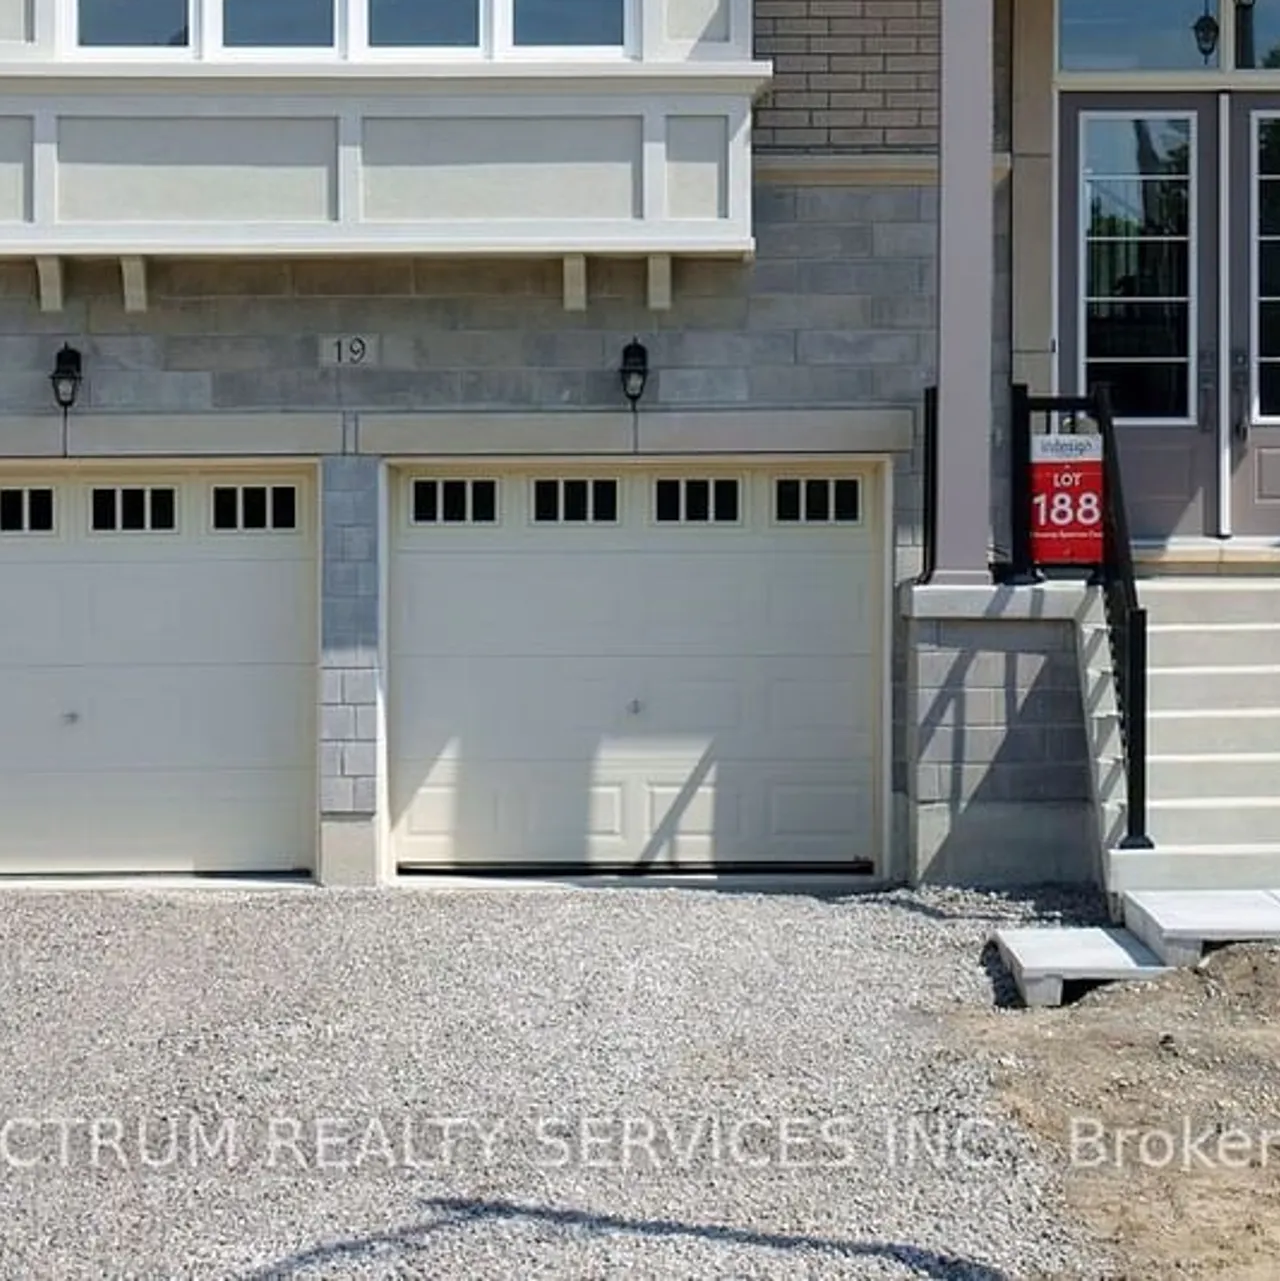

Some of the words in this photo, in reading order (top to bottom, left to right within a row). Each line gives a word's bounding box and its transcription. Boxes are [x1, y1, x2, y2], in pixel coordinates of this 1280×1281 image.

[334, 337, 366, 365] 19
[1053, 473, 1083, 487] LOT
[1033, 492, 1101, 526] 188
